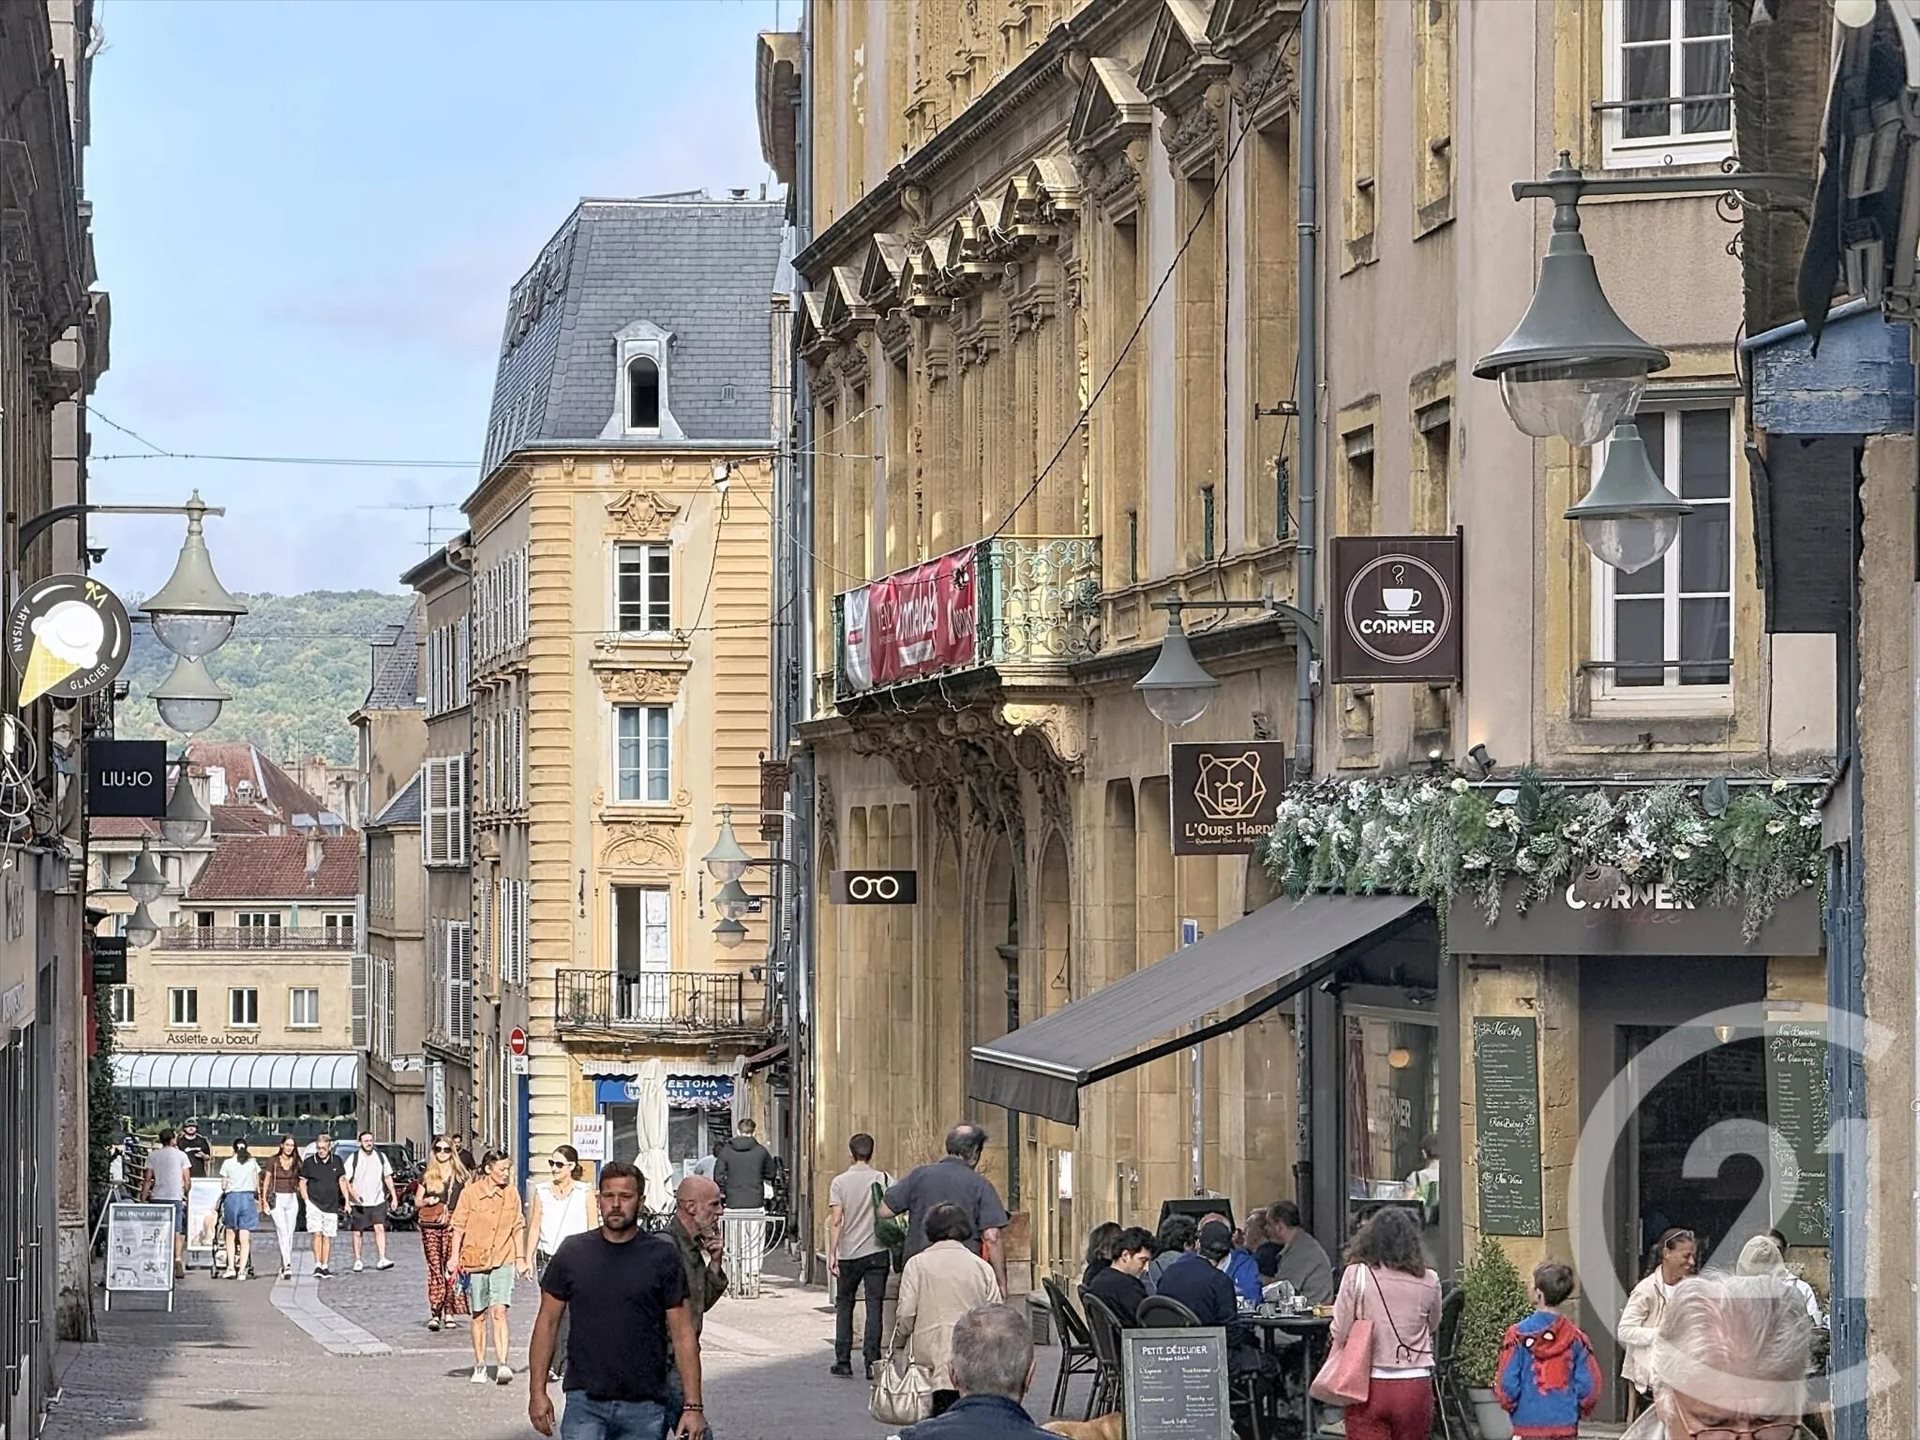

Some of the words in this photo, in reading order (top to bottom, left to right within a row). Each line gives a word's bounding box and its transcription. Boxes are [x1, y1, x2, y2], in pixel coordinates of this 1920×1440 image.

[12, 605, 30, 652] ARTISAN
[1360, 619, 1435, 634] CORNER
[69, 663, 110, 690] GLACIER
[211, 1037, 224, 1045] au
[665, 1080, 718, 1088] EETCHA
[1142, 1347, 1163, 1355] PETIT
[1166, 1344, 1208, 1355] DÉJEUNER
